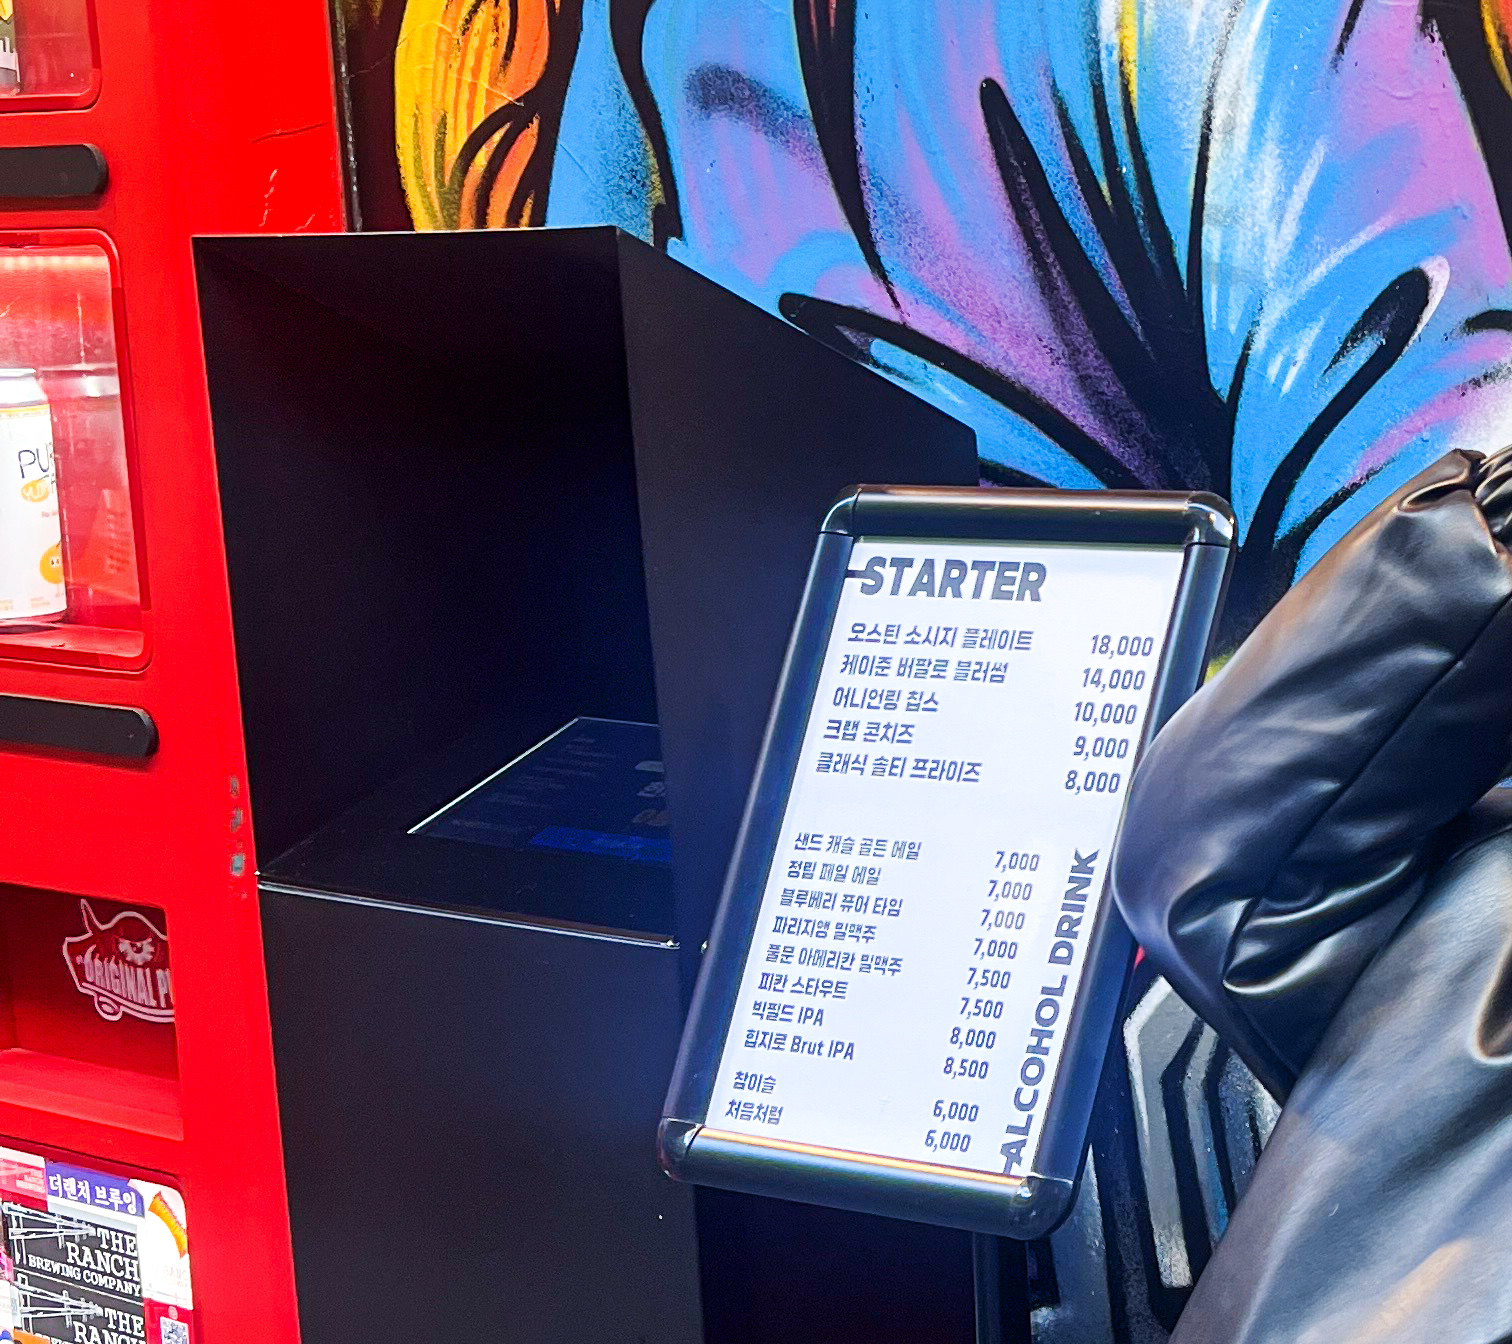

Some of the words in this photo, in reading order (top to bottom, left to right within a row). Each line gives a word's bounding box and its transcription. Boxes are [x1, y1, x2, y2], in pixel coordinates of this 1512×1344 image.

[859, 556, 1048, 602] STARTER
[847, 622, 901, 646] 오스틴
[903, 626, 958, 648] 소시지
[962, 628, 1034, 652] 플레이트
[1090, 634, 1153, 657] 18,000
[840, 655, 895, 677] 케이준
[897, 657, 950, 680] 버팔로
[953, 661, 1008, 684] 블러썸
[1082, 668, 1145, 692] 14,000
[832, 687, 901, 711] 어니언링
[906, 690, 939, 713] 칩스
[1073, 701, 1137, 725] 10,000
[823, 719, 860, 741] 크랩
[863, 722, 915, 744] 콘치즈
[1073, 736, 1128, 760] 9,000
[816, 752, 868, 776] 클래식
[871, 756, 907, 779] 솔티
[909, 759, 982, 783] 프라이즈
[1064, 770, 1120, 795] 8,000
[794, 832, 823, 851] 샌드
[826, 835, 855, 855] 캐슬
[859, 838, 888, 857] 골든
[891, 841, 922, 861] 에일
[995, 851, 1040, 874] 7,000
[819, 863, 849, 883] 페일
[852, 866, 882, 885] 에일
[988, 880, 1032, 902] 7,000
[780, 888, 837, 911] 블루베리
[840, 894, 870, 914] 퓨어
[873, 897, 903, 917] 타임
[980, 909, 1025, 931] 7,000
[772, 916, 830, 938] 파리지앵
[833, 922, 877, 943] 밀맥주
[973, 938, 1018, 961] 7,000
[798, 947, 855, 971] 아메리칸
[859, 954, 903, 976] 밀맥주
[967, 968, 1011, 990] 7,500
[758, 973, 788, 993] 피칸
[790, 976, 849, 999] 스타우트
[960, 997, 1004, 1020] 7,500
[1000, 974, 1068, 1168] ALCOHOL
[1048, 848, 1101, 966] DRINK
[752, 1000, 795, 1023] 빅필드
[797, 1006, 824, 1026] IPA
[950, 1027, 996, 1050] 8,000
[744, 1029, 788, 1051] 힙지로
[790, 1036, 824, 1056] Brut
[828, 1040, 855, 1060] IPA
[943, 1057, 989, 1080] 8,500
[733, 1071, 776, 1094] 참이슬
[933, 1100, 979, 1123] 6,000
[725, 1099, 783, 1125] 처음처럼
[925, 1130, 971, 1153] 6,000
[49, 1174, 90, 1204] 더랜치
[95, 1186, 137, 1214] 브루잉
[66, 1242, 141, 1282] RANCH
[97, 1228, 138, 1256] THE
[28, 1255, 81, 1280] BREWING
[83, 1270, 141, 1297] COMPANY
[104, 1308, 145, 1337] THE
